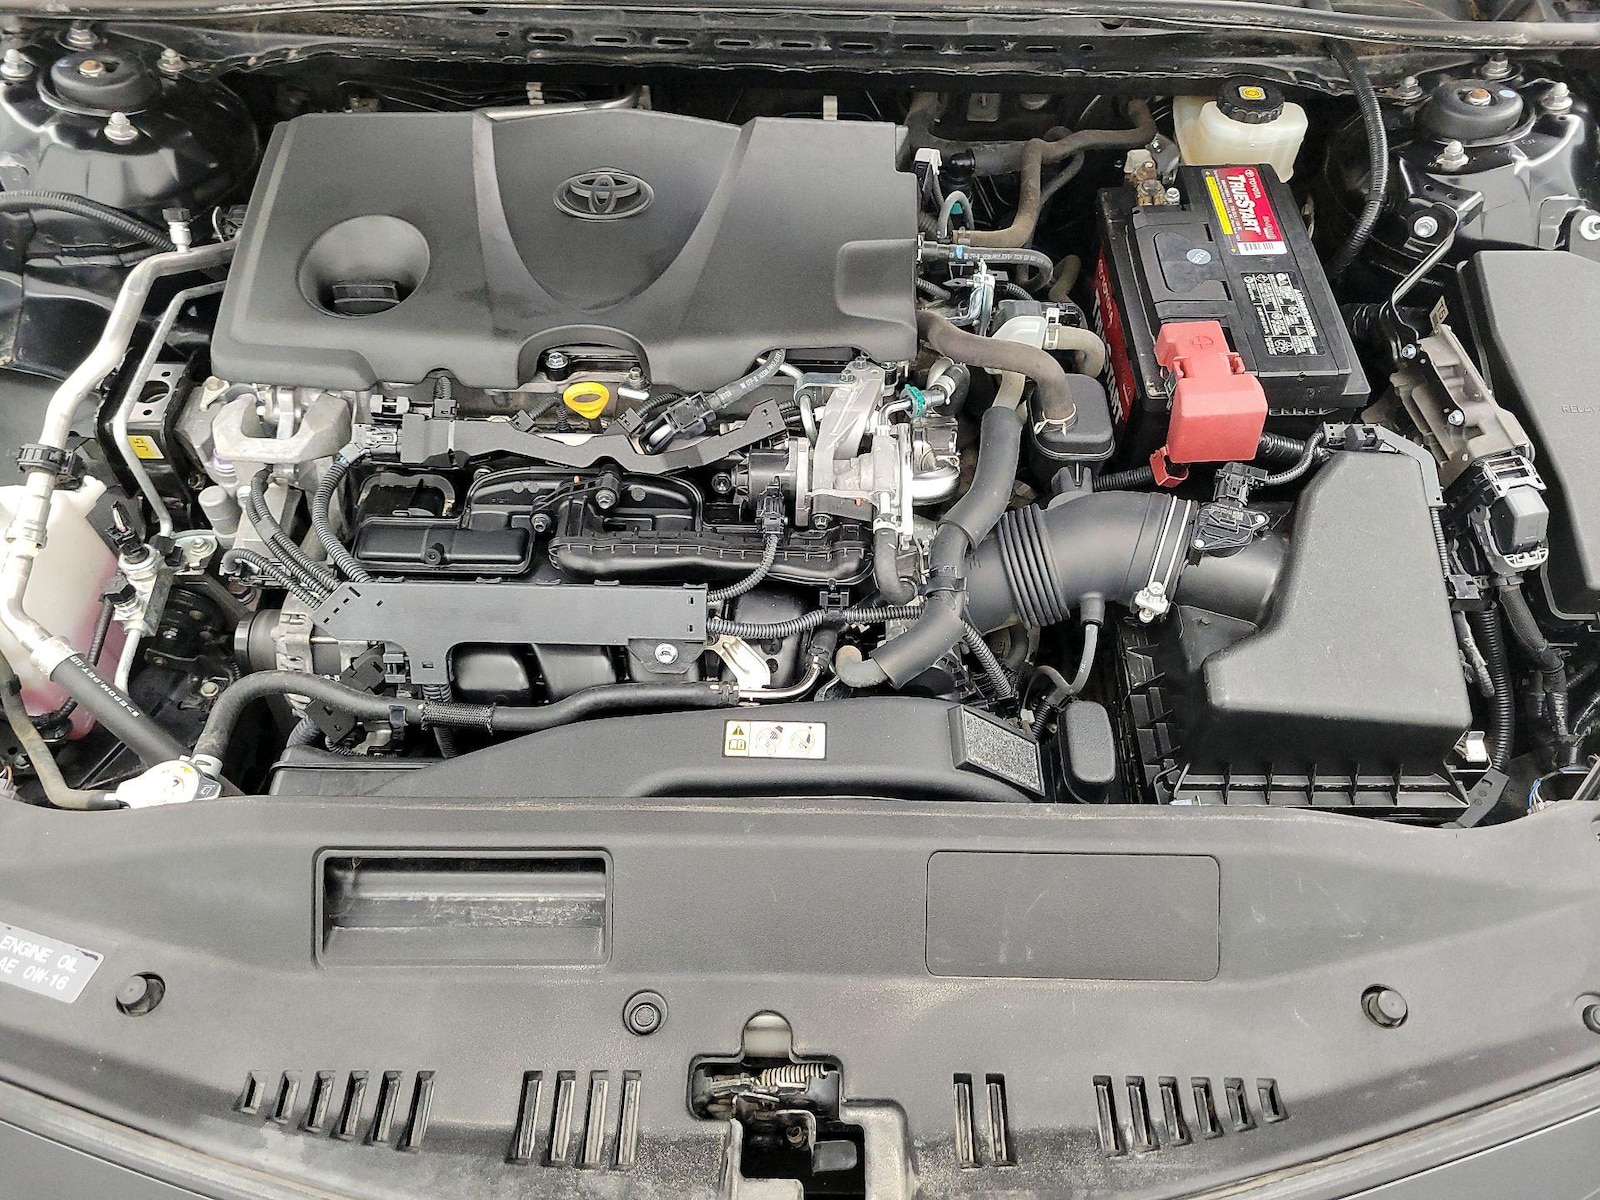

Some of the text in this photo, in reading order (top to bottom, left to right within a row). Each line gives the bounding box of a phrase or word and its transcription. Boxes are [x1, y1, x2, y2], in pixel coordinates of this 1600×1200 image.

[1248, 177, 1262, 199] TOYOTA
[0, 935, 79, 973] ENGINE OIL
[0, 957, 20, 974] AE
